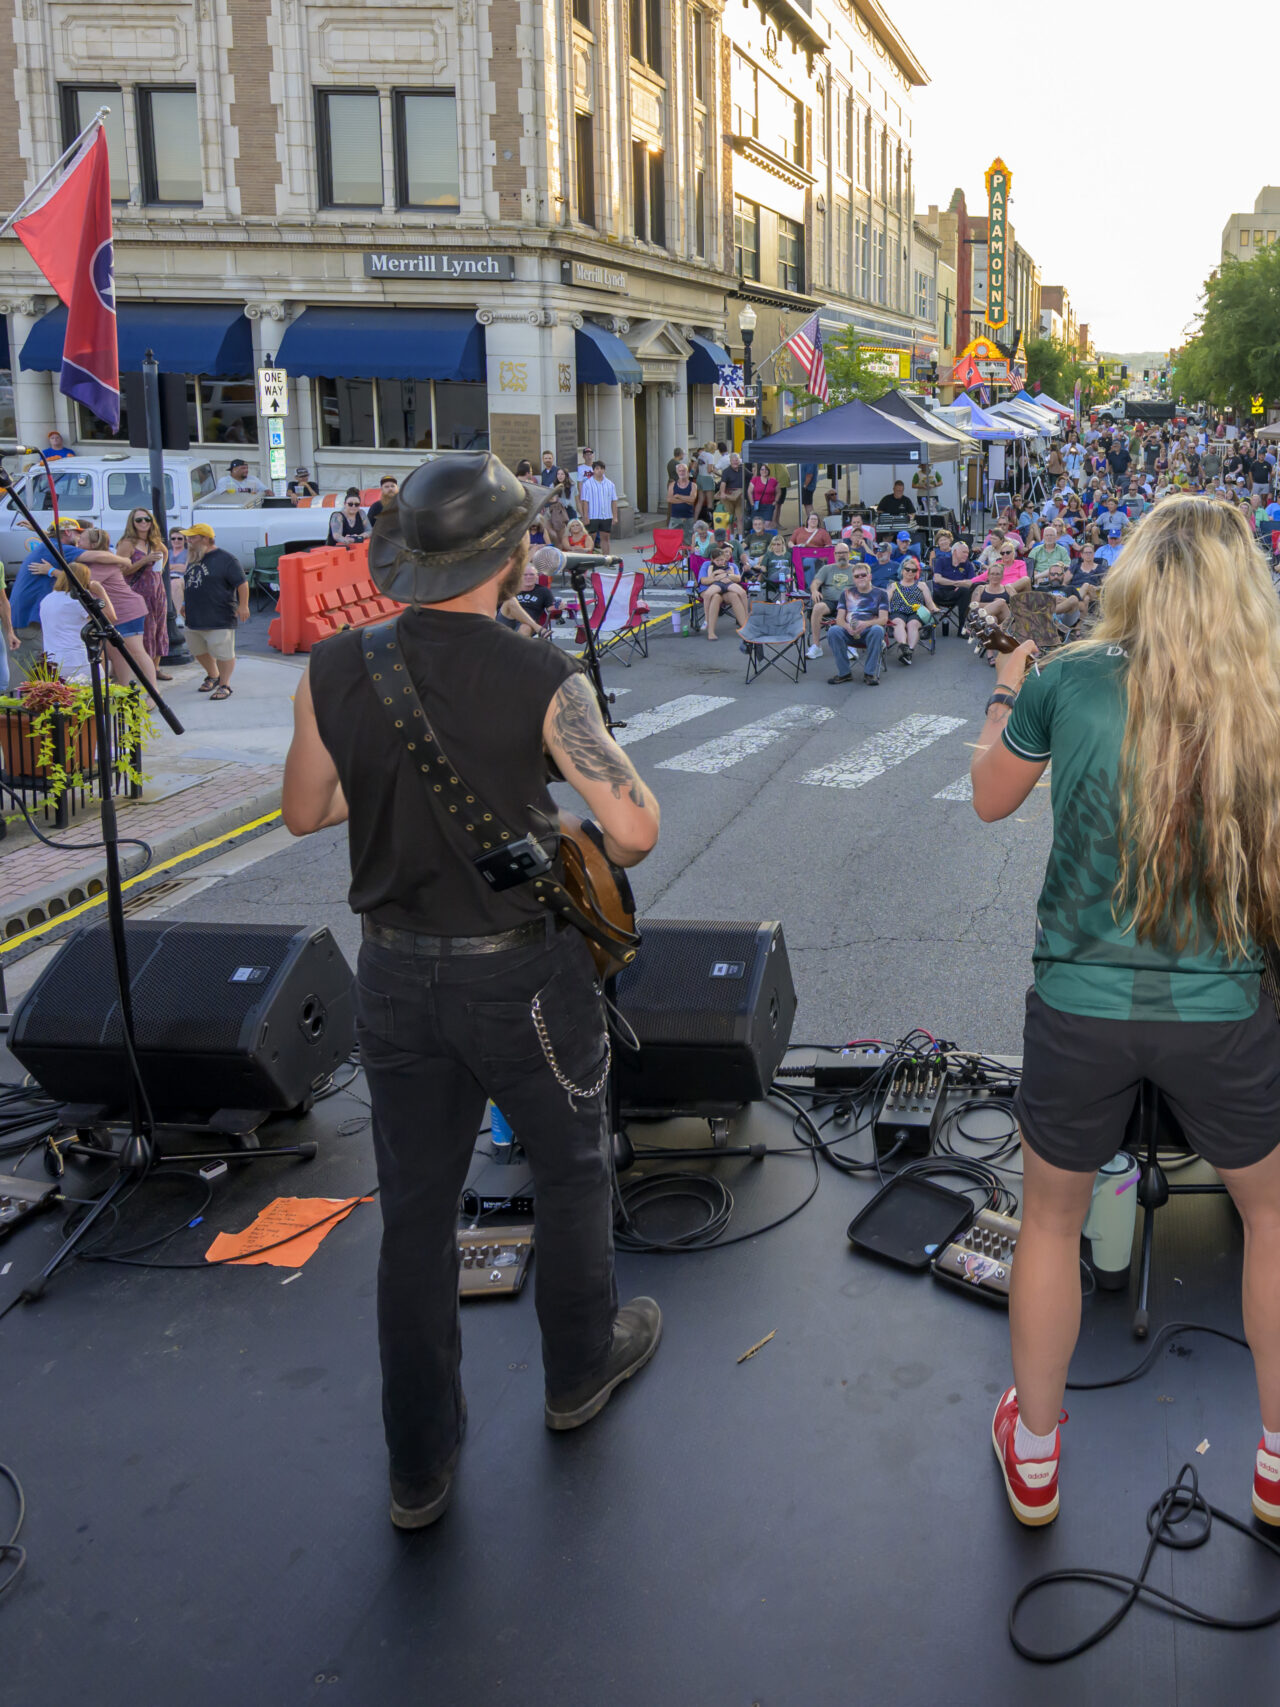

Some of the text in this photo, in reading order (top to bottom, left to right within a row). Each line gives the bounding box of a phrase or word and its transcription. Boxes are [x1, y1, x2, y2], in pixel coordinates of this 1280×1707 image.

[991, 174, 1004, 320] PARAMOUNT
[370, 254, 500, 277] Merrill Lynch
[576, 264, 626, 288] Merrill Lynch
[264, 373, 282, 382] ONE
[264, 386, 283, 395] WAY
[1258, 1461, 1279, 1475] adidas
[1027, 1471, 1050, 1480] adidas
